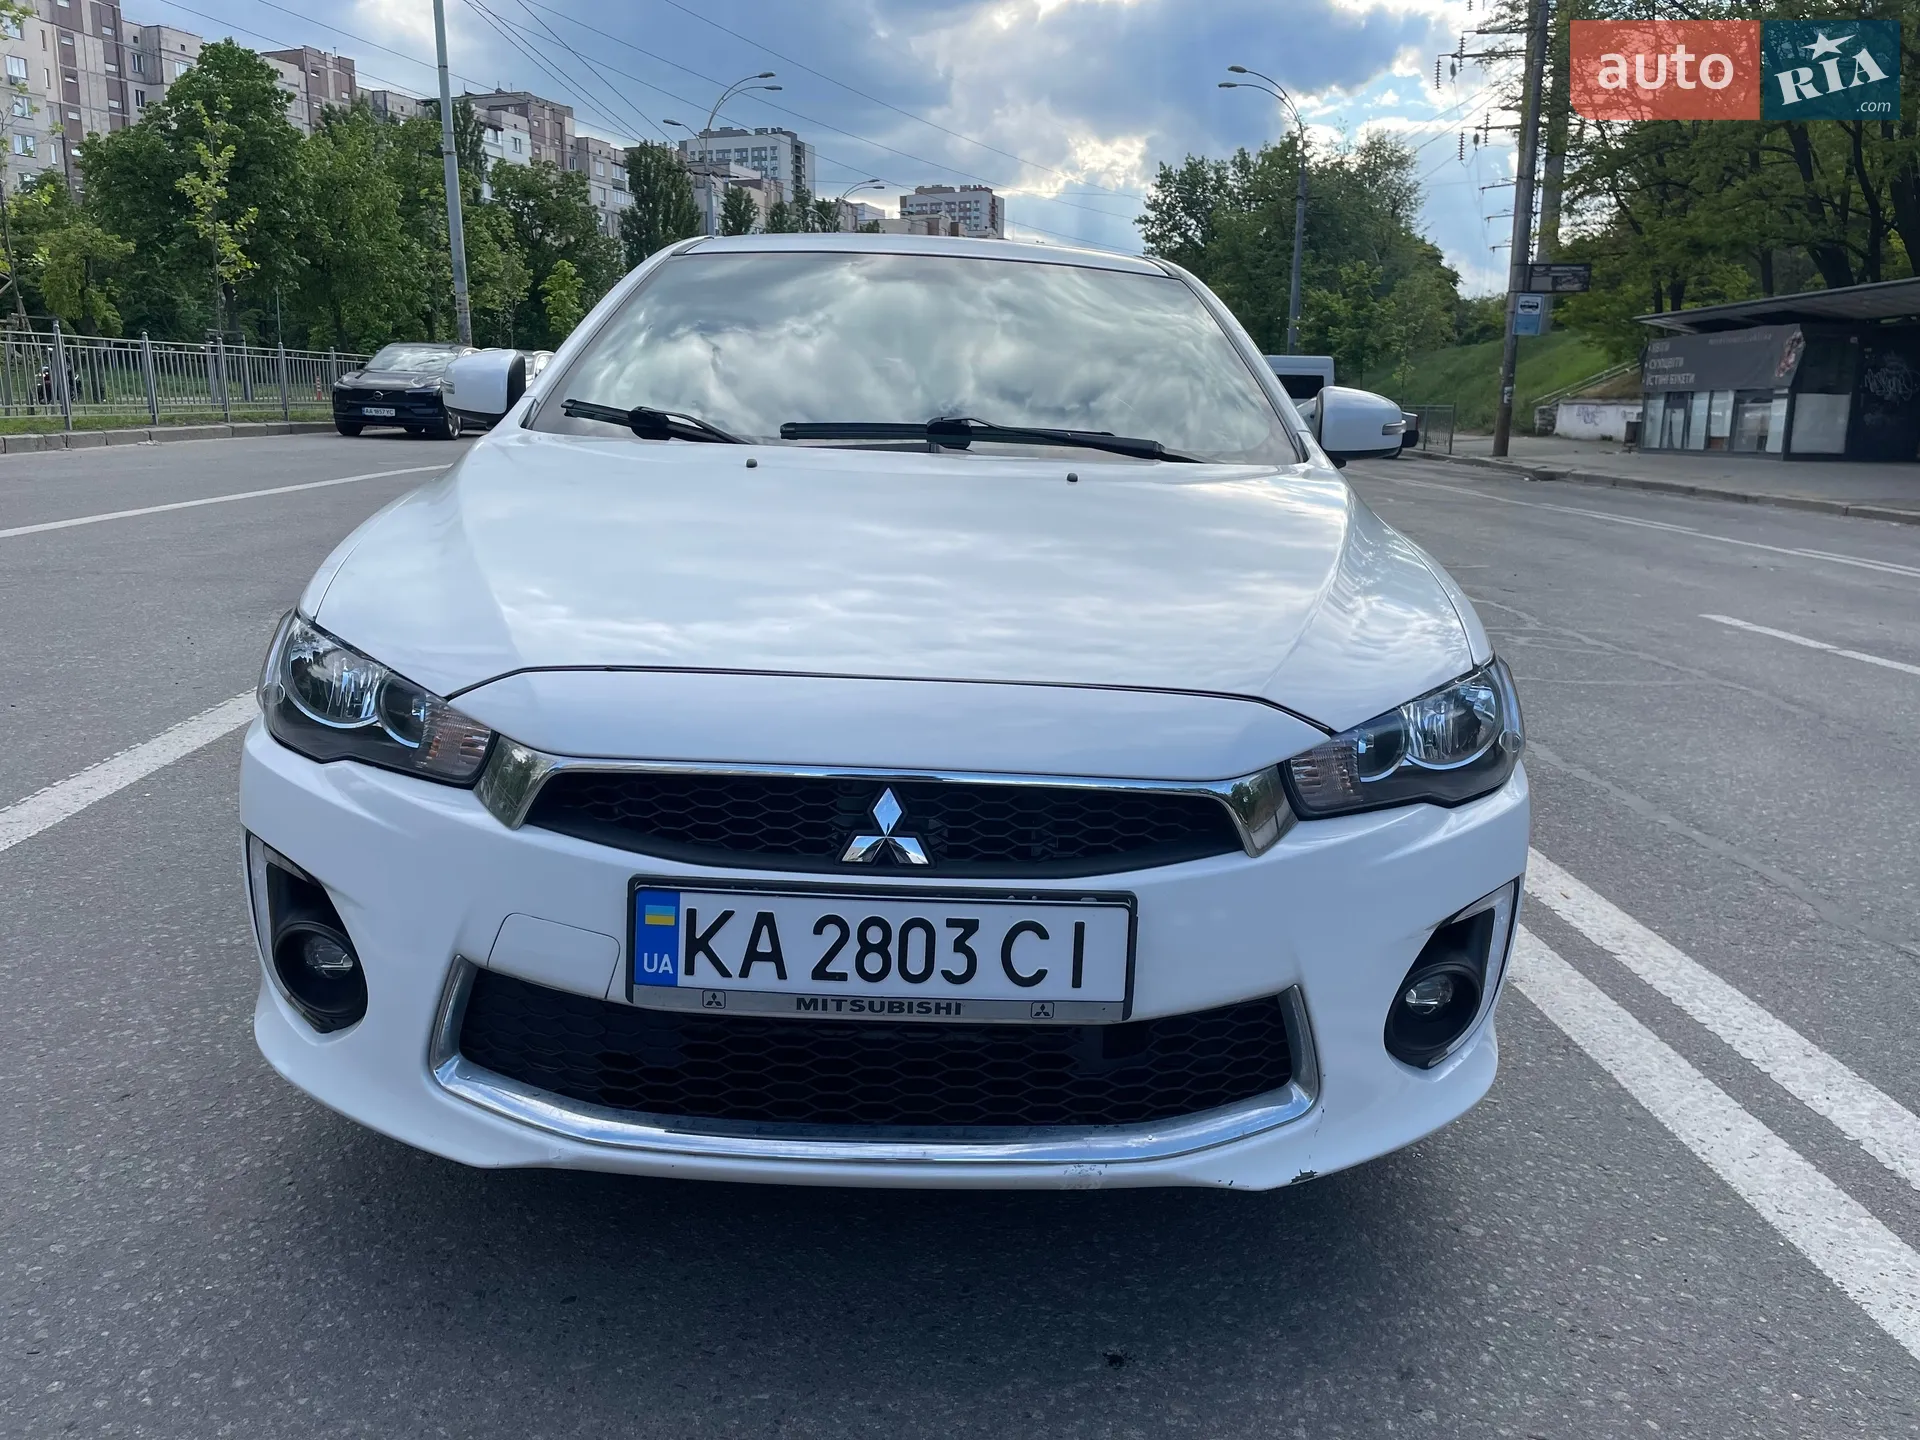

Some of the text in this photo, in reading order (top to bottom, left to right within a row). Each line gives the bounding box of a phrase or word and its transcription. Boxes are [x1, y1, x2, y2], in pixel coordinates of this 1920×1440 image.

[683, 907, 1085, 989] KA 2803 CI
[643, 952, 674, 974] UA
[796, 997, 962, 1015] MITSUBISHI
